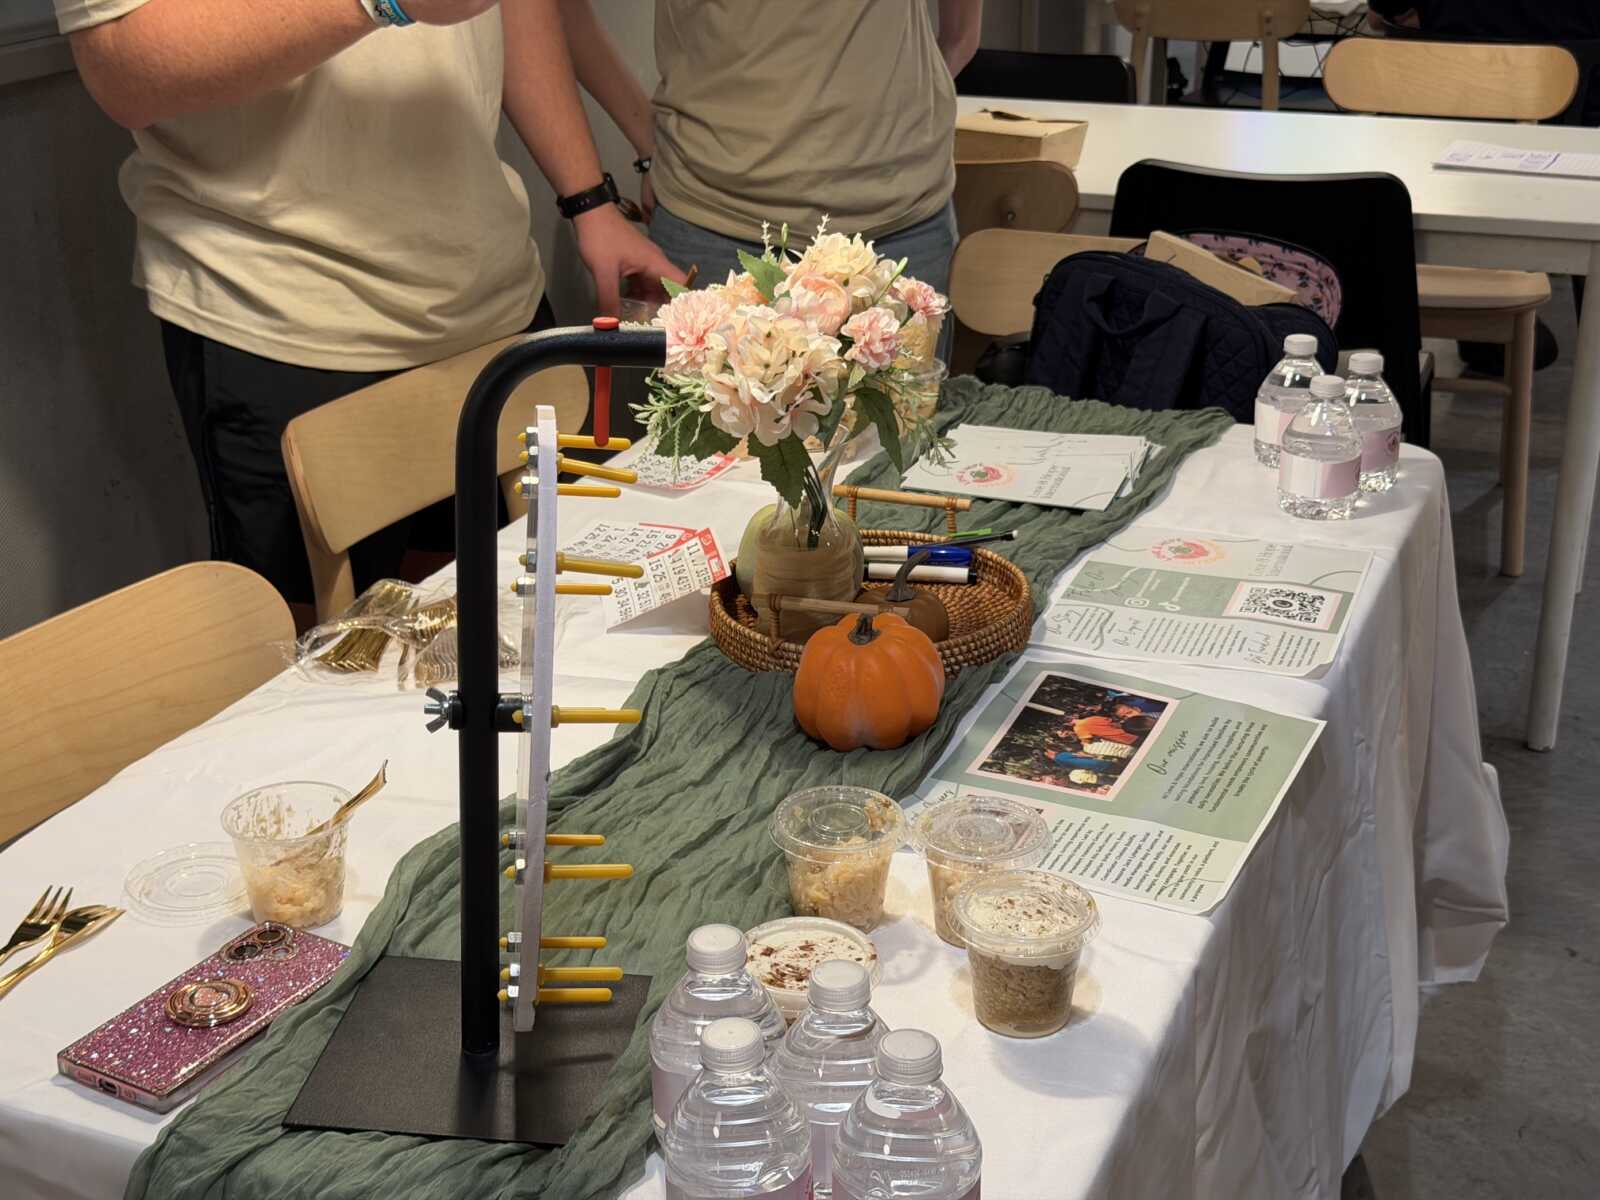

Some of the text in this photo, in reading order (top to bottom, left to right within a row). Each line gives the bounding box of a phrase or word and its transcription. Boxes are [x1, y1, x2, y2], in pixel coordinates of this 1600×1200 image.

[687, 542, 701, 555] 11
[649, 559, 663, 571] 15
[672, 565, 686, 575] 19
[653, 572, 667, 583] 25
[1146, 759, 1169, 776] Our
